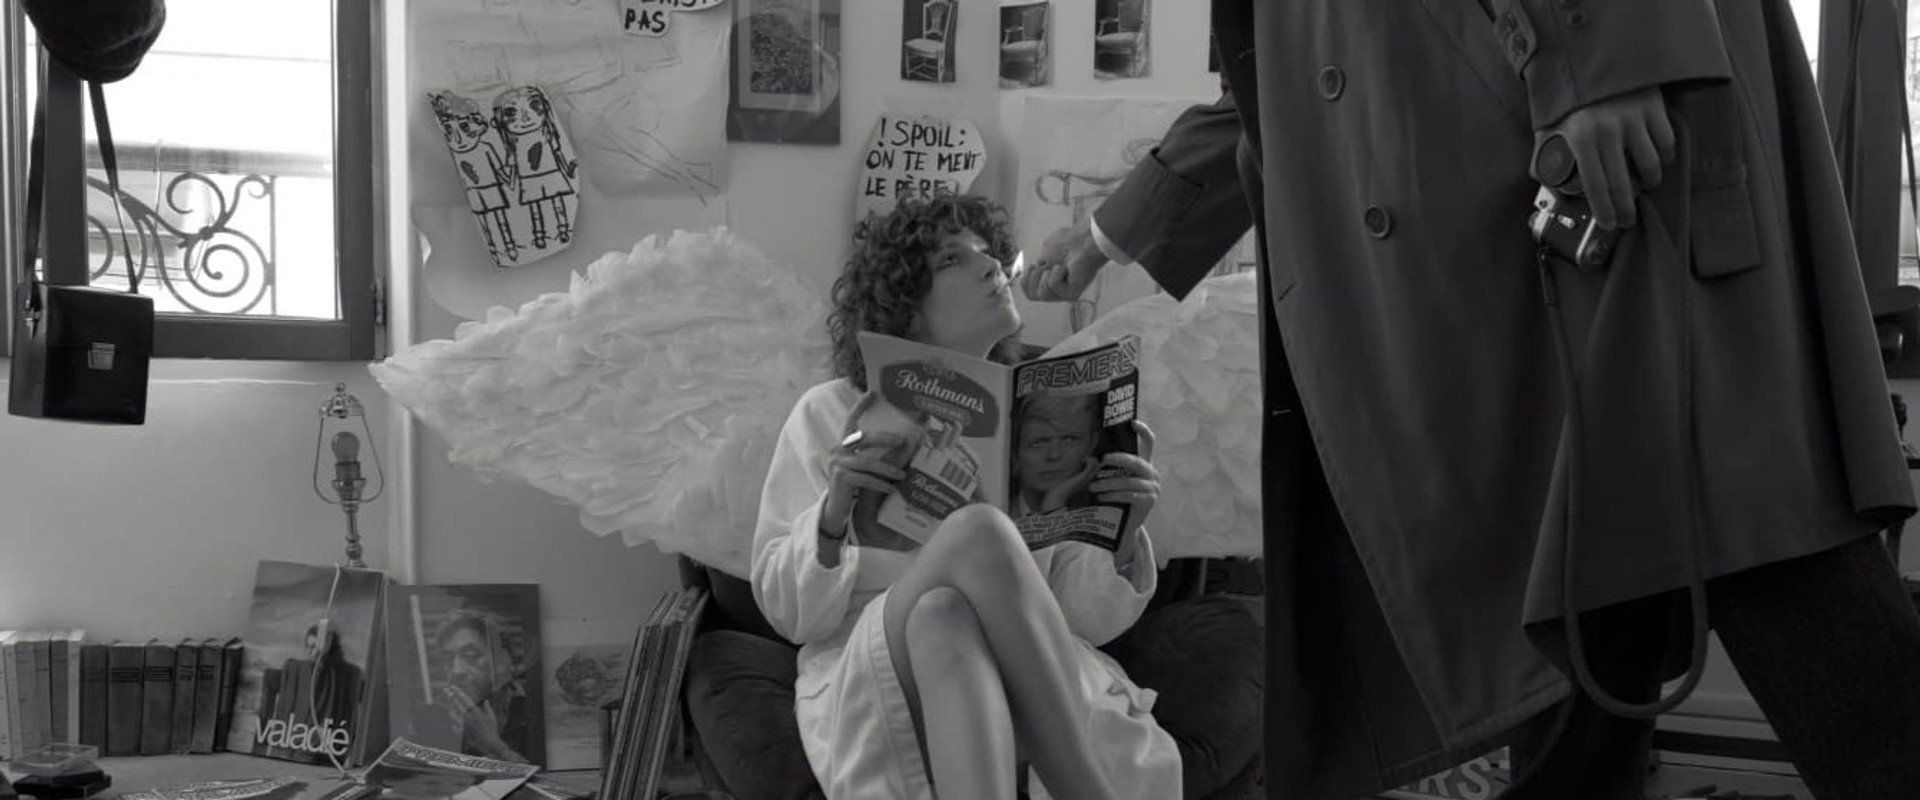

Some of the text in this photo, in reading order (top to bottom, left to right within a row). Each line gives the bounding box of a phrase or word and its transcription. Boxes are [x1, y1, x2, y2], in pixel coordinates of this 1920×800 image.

[624, 7, 666, 33] PAS
[865, 149, 981, 173] ON TE MENT
[865, 176, 886, 196] LE
[895, 369, 984, 414] Rothmans
[1107, 383, 1134, 404] DAVID
[1103, 397, 1134, 420] BOWIE
[255, 712, 350, 756] valadié
